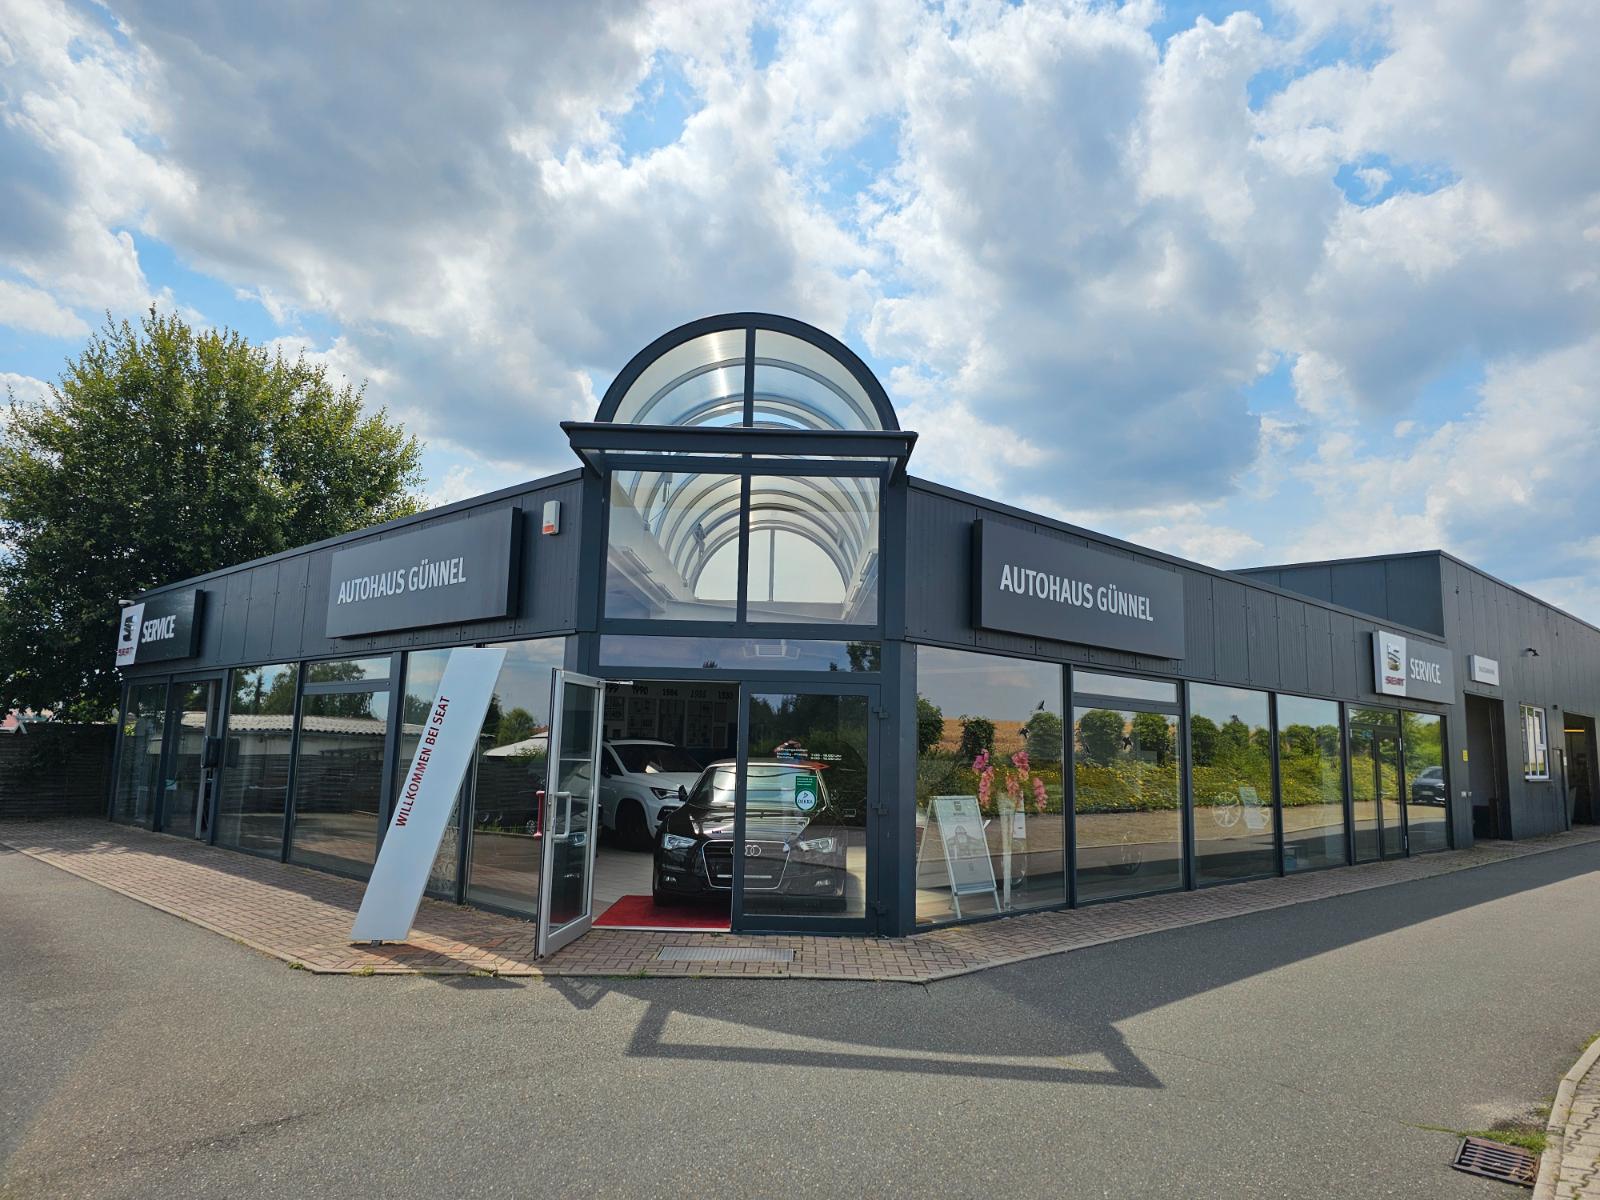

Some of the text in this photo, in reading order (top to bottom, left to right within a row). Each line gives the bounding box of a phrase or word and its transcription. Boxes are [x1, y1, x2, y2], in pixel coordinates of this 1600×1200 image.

[337, 557, 466, 605] AUTOHAUS GÜNNEL
[1000, 564, 1154, 622] AUTOHAUS GÜNNEL
[141, 615, 176, 643] SERVICE
[1409, 657, 1441, 685] SERVICE
[395, 696, 450, 827] WILLKOMMEN BEI SEAT
